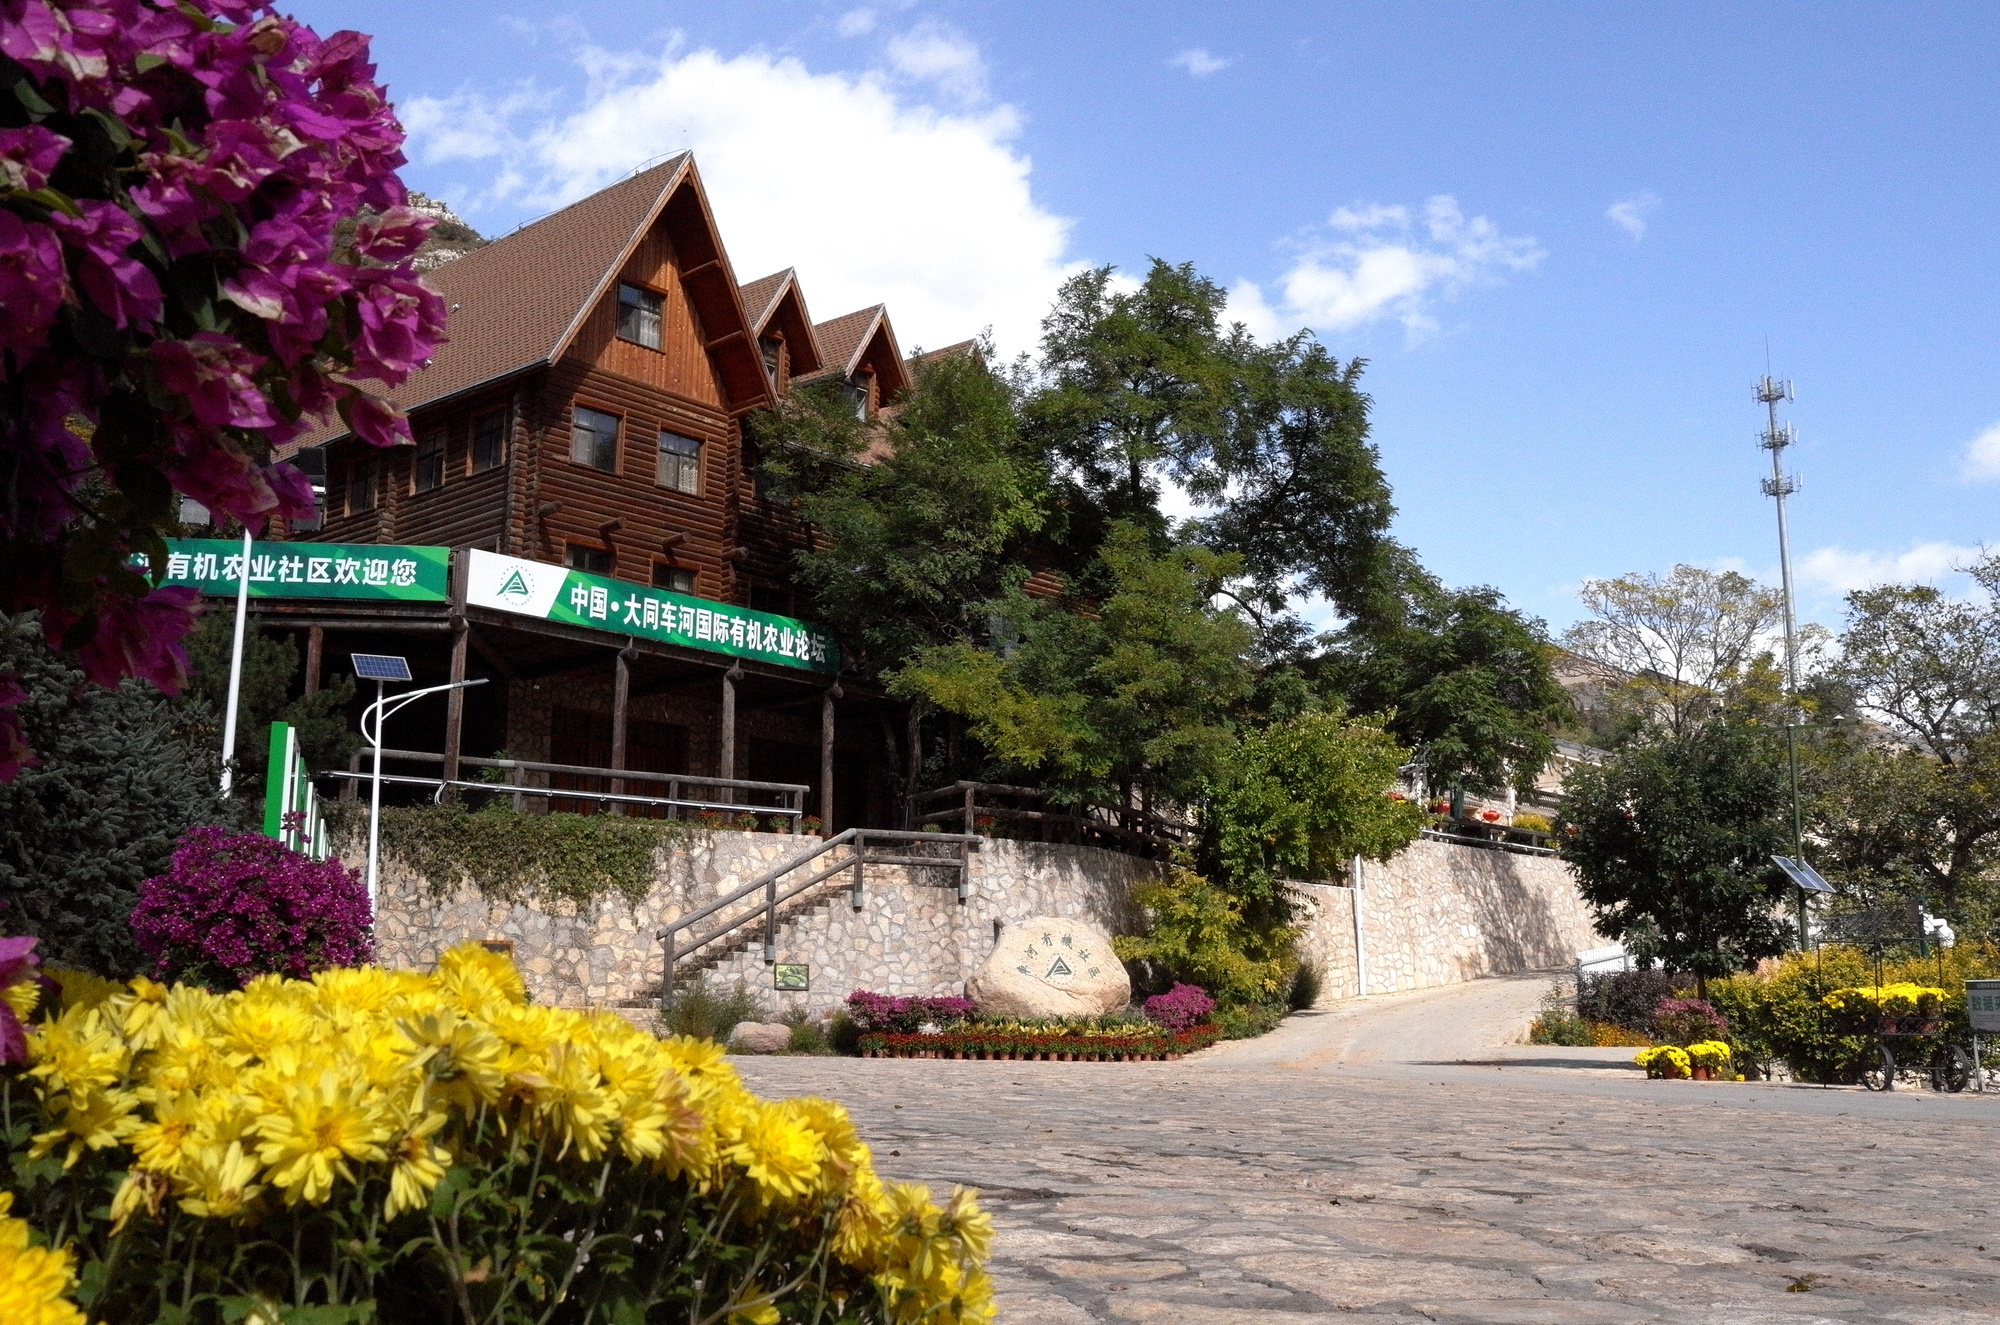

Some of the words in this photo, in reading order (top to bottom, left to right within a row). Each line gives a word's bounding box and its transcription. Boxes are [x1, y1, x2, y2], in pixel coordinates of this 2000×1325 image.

[131, 551, 417, 586] 有机农业社区欢迎您
